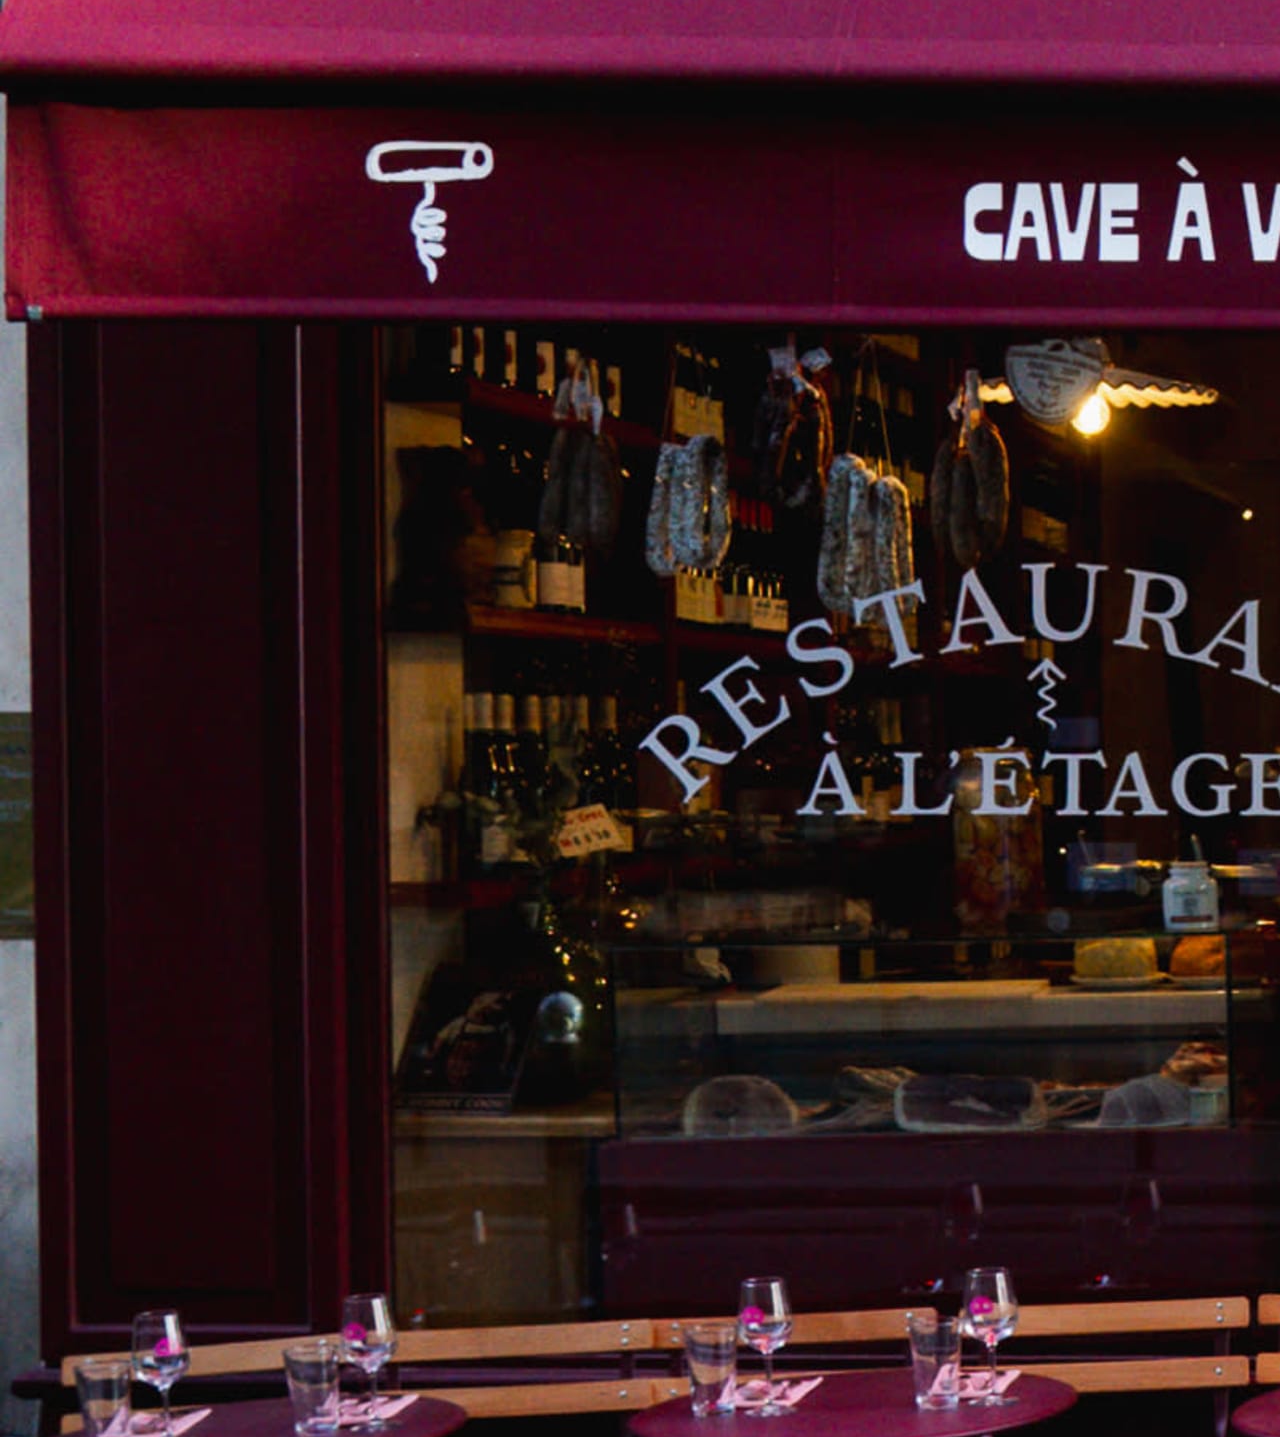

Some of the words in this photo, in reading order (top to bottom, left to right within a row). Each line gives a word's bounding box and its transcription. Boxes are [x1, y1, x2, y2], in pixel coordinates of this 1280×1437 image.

[963, 182, 1140, 263] CAVE
[1166, 156, 1216, 262] À
[796, 732, 868, 816] À
